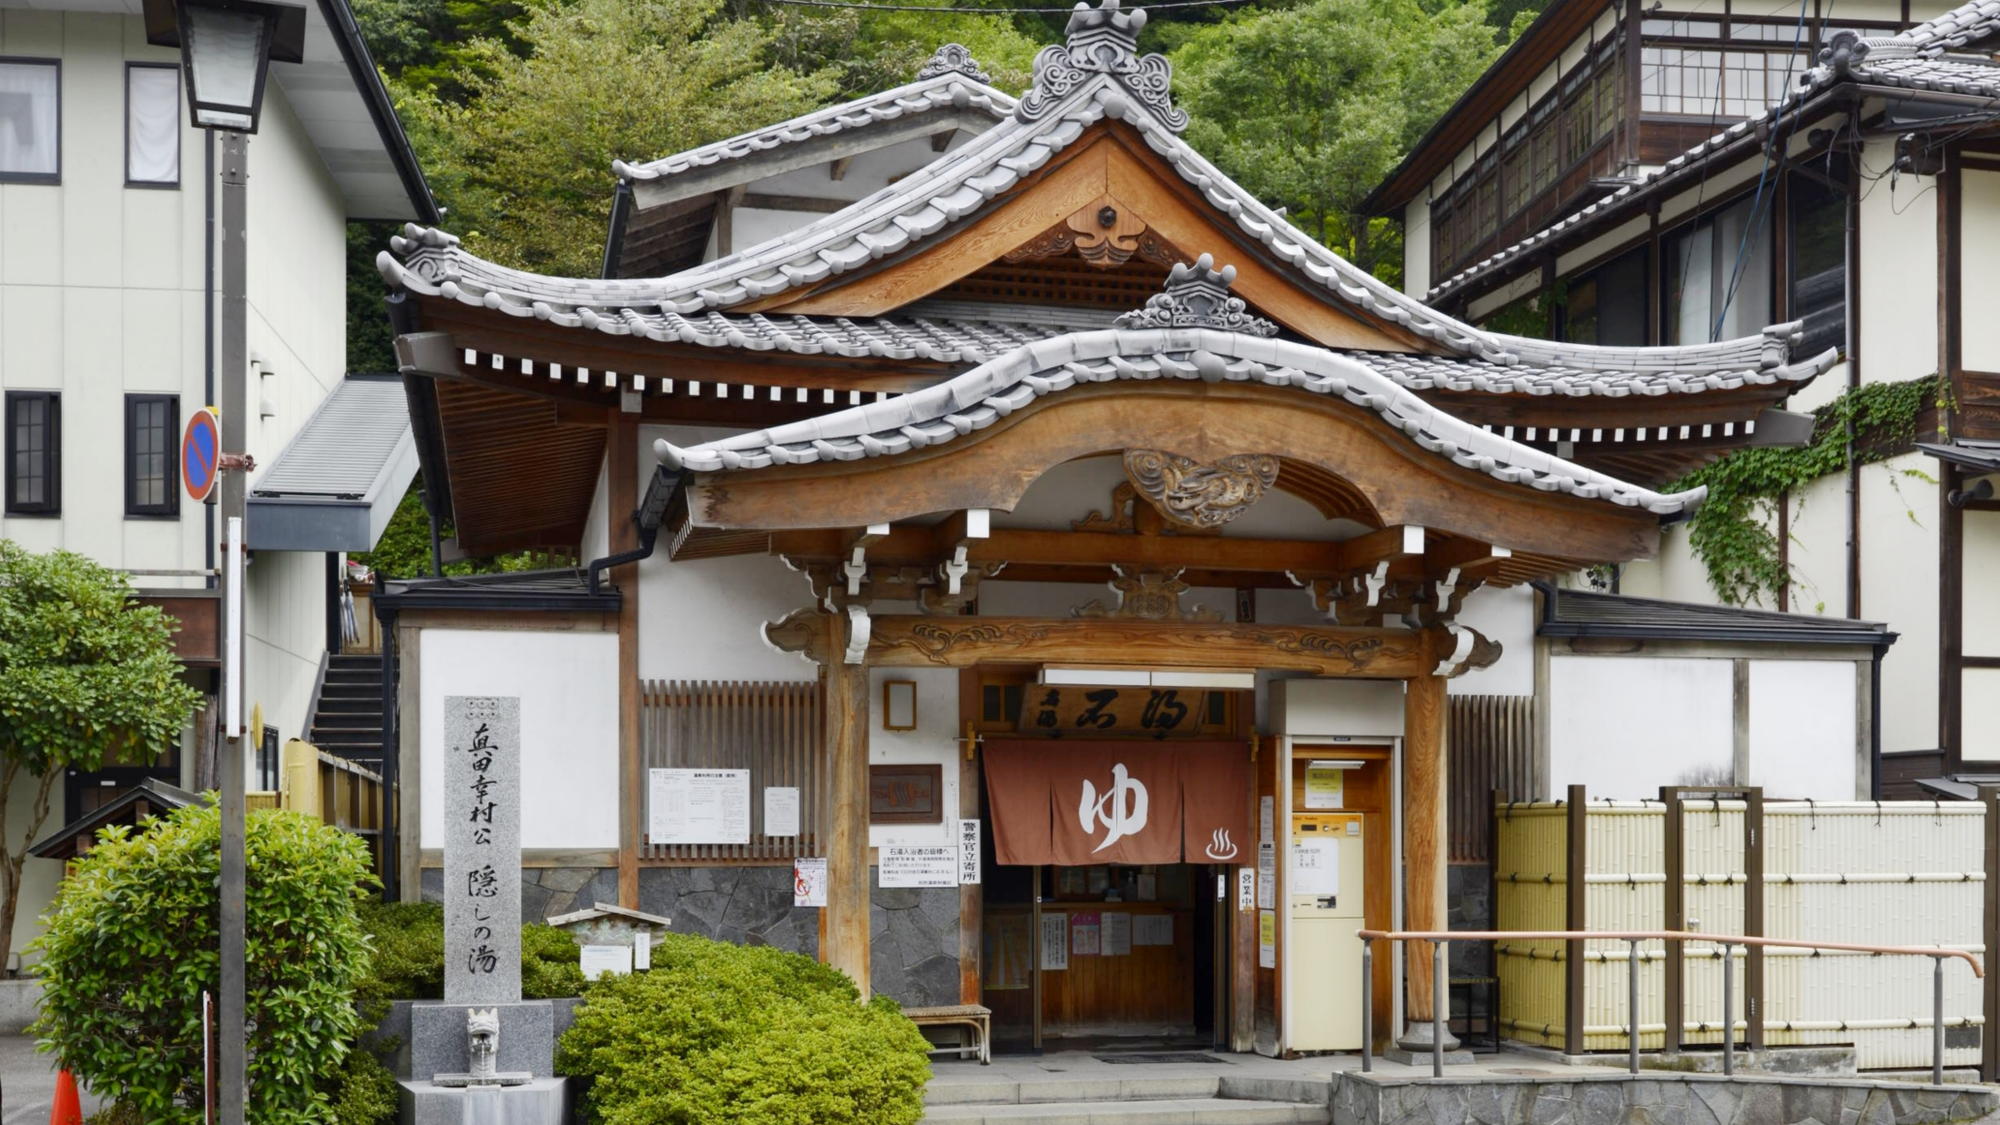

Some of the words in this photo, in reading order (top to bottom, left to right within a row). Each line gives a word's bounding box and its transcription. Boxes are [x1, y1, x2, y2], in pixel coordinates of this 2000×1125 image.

[467, 723, 499, 846] 真田幸村公
[1078, 762, 1149, 855] ゆ
[962, 822, 977, 882] 警察官立寄所
[467, 864, 499, 975] 隠しの湯
